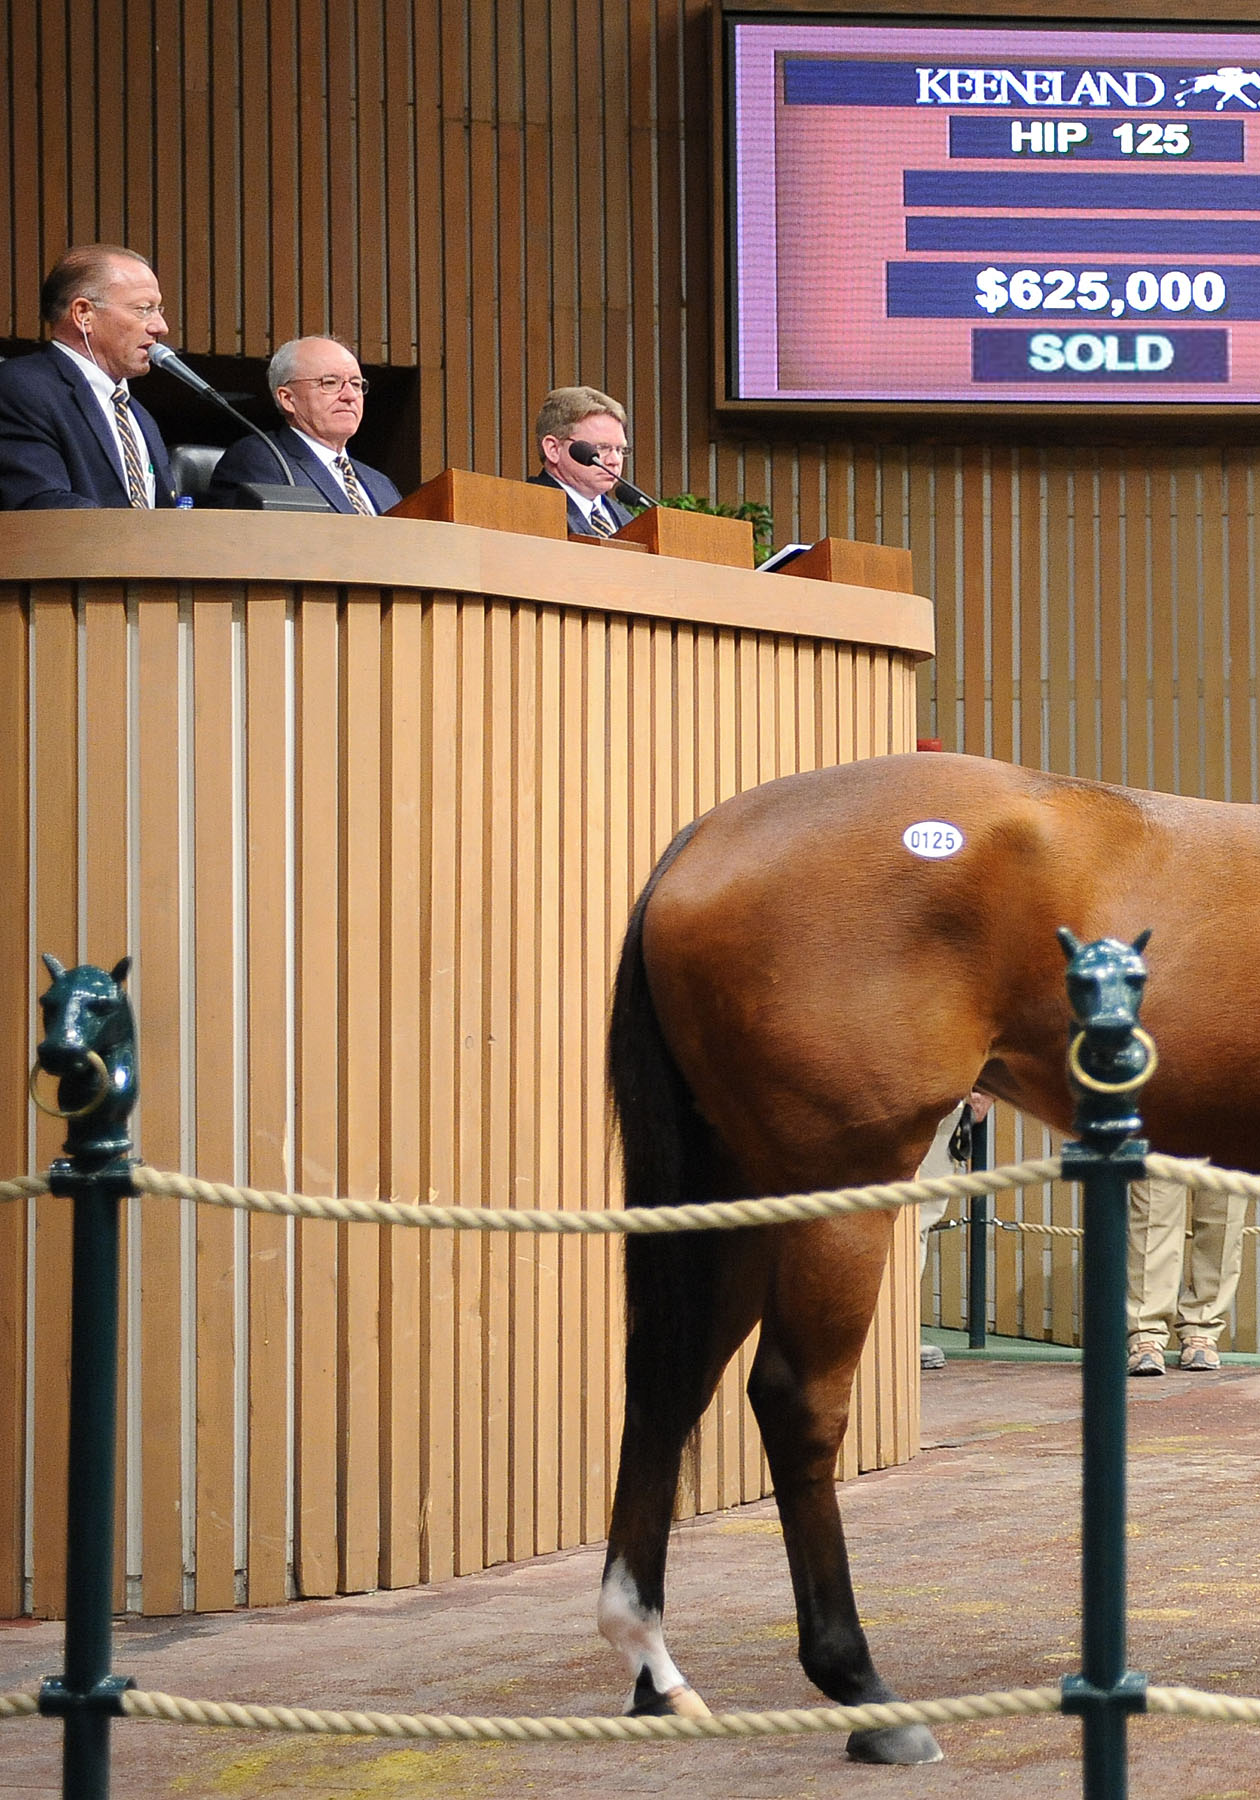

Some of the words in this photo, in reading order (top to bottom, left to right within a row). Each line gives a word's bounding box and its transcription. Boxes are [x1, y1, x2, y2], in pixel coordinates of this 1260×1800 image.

[916, 68, 1165, 108] KEENELAND
[1011, 121, 1088, 153] HIP
[1112, 122, 1190, 155] 125
[975, 267, 1226, 317] $625,000
[1029, 333, 1174, 372] SOLD
[911, 830, 955, 850] 0125
